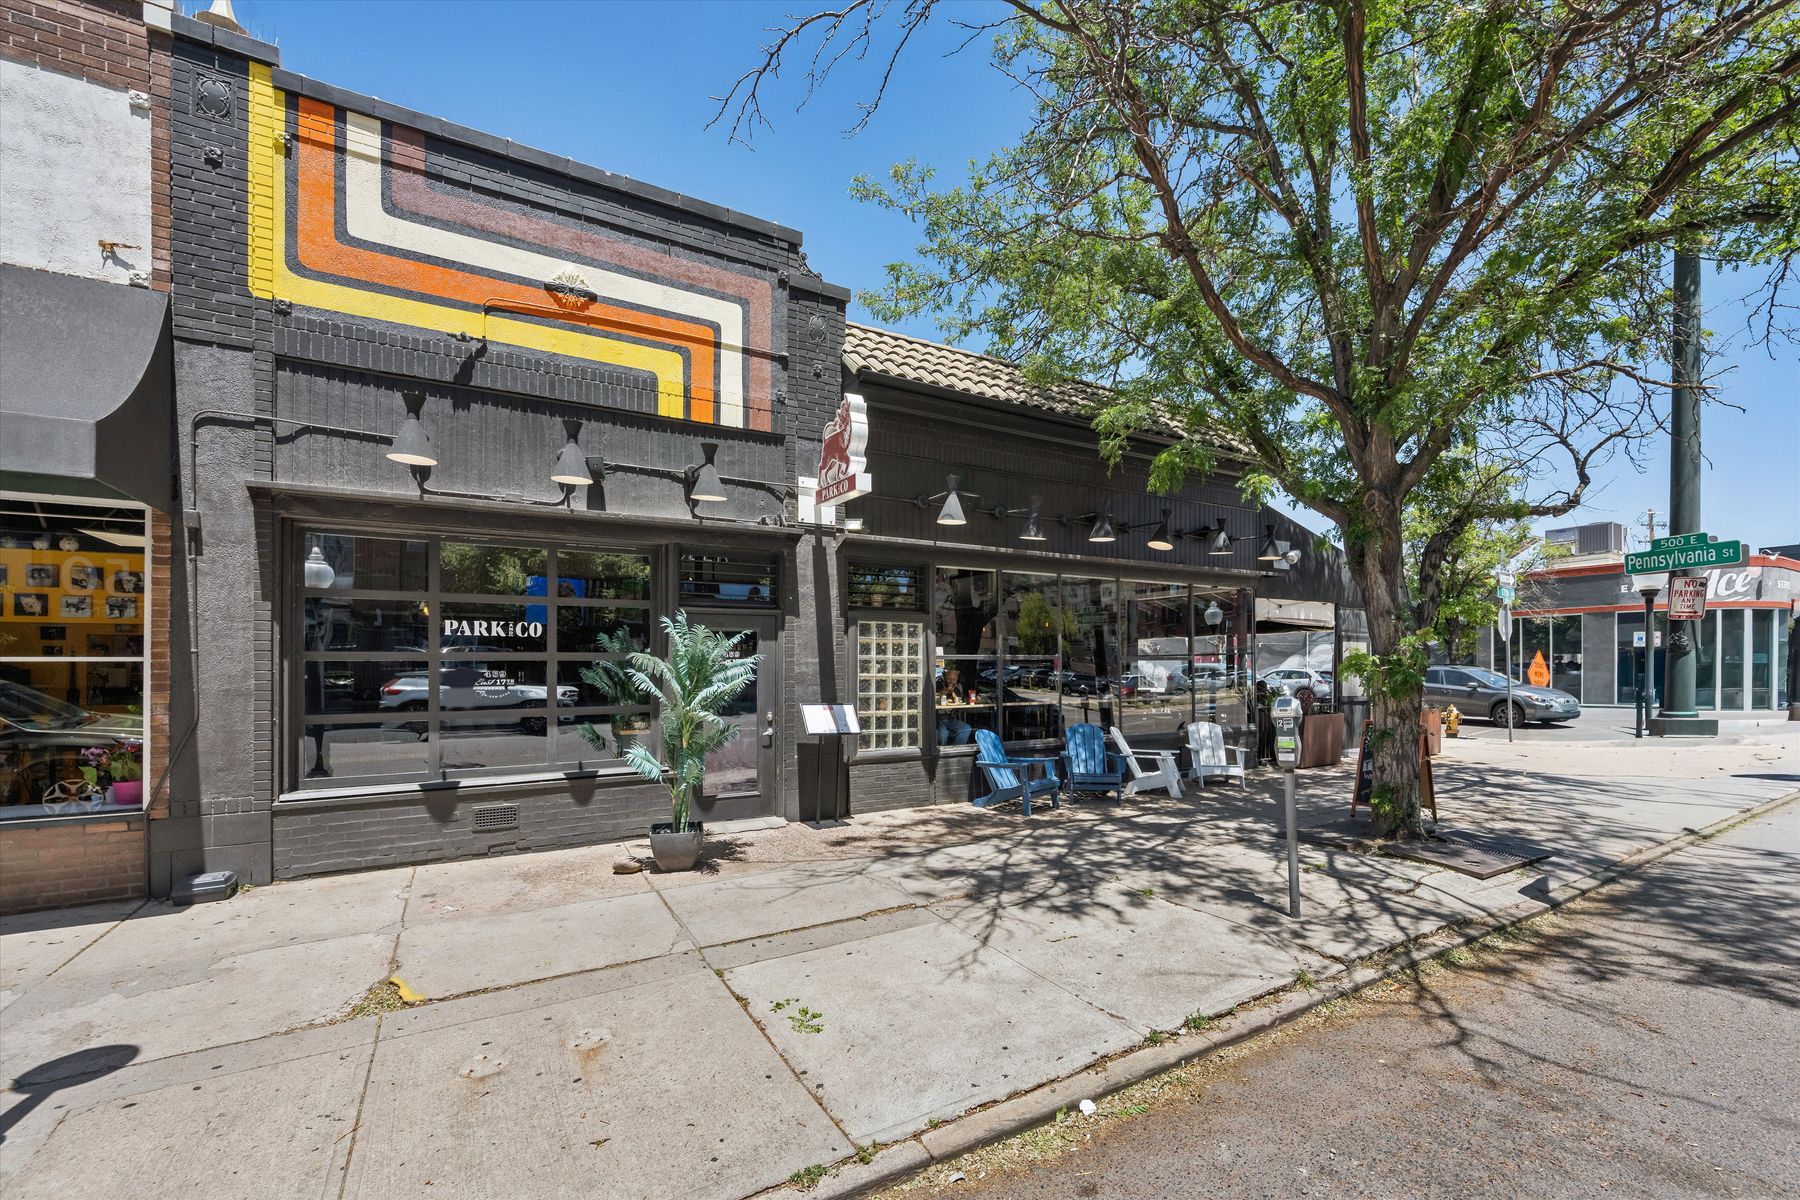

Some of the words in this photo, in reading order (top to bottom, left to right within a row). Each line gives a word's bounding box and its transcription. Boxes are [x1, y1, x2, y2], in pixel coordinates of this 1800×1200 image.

[821, 484, 838, 501] PARK
[840, 480, 849, 493] CO
[1661, 538, 1684, 548] 500
[1691, 535, 1698, 544] E
[1628, 546, 1716, 570] Pennsylvania
[1722, 548, 1734, 557] St
[1683, 580, 1698, 588] NO
[1673, 589, 1704, 598] PARKING
[444, 620, 507, 637] PARK
[515, 621, 543, 638] CO
